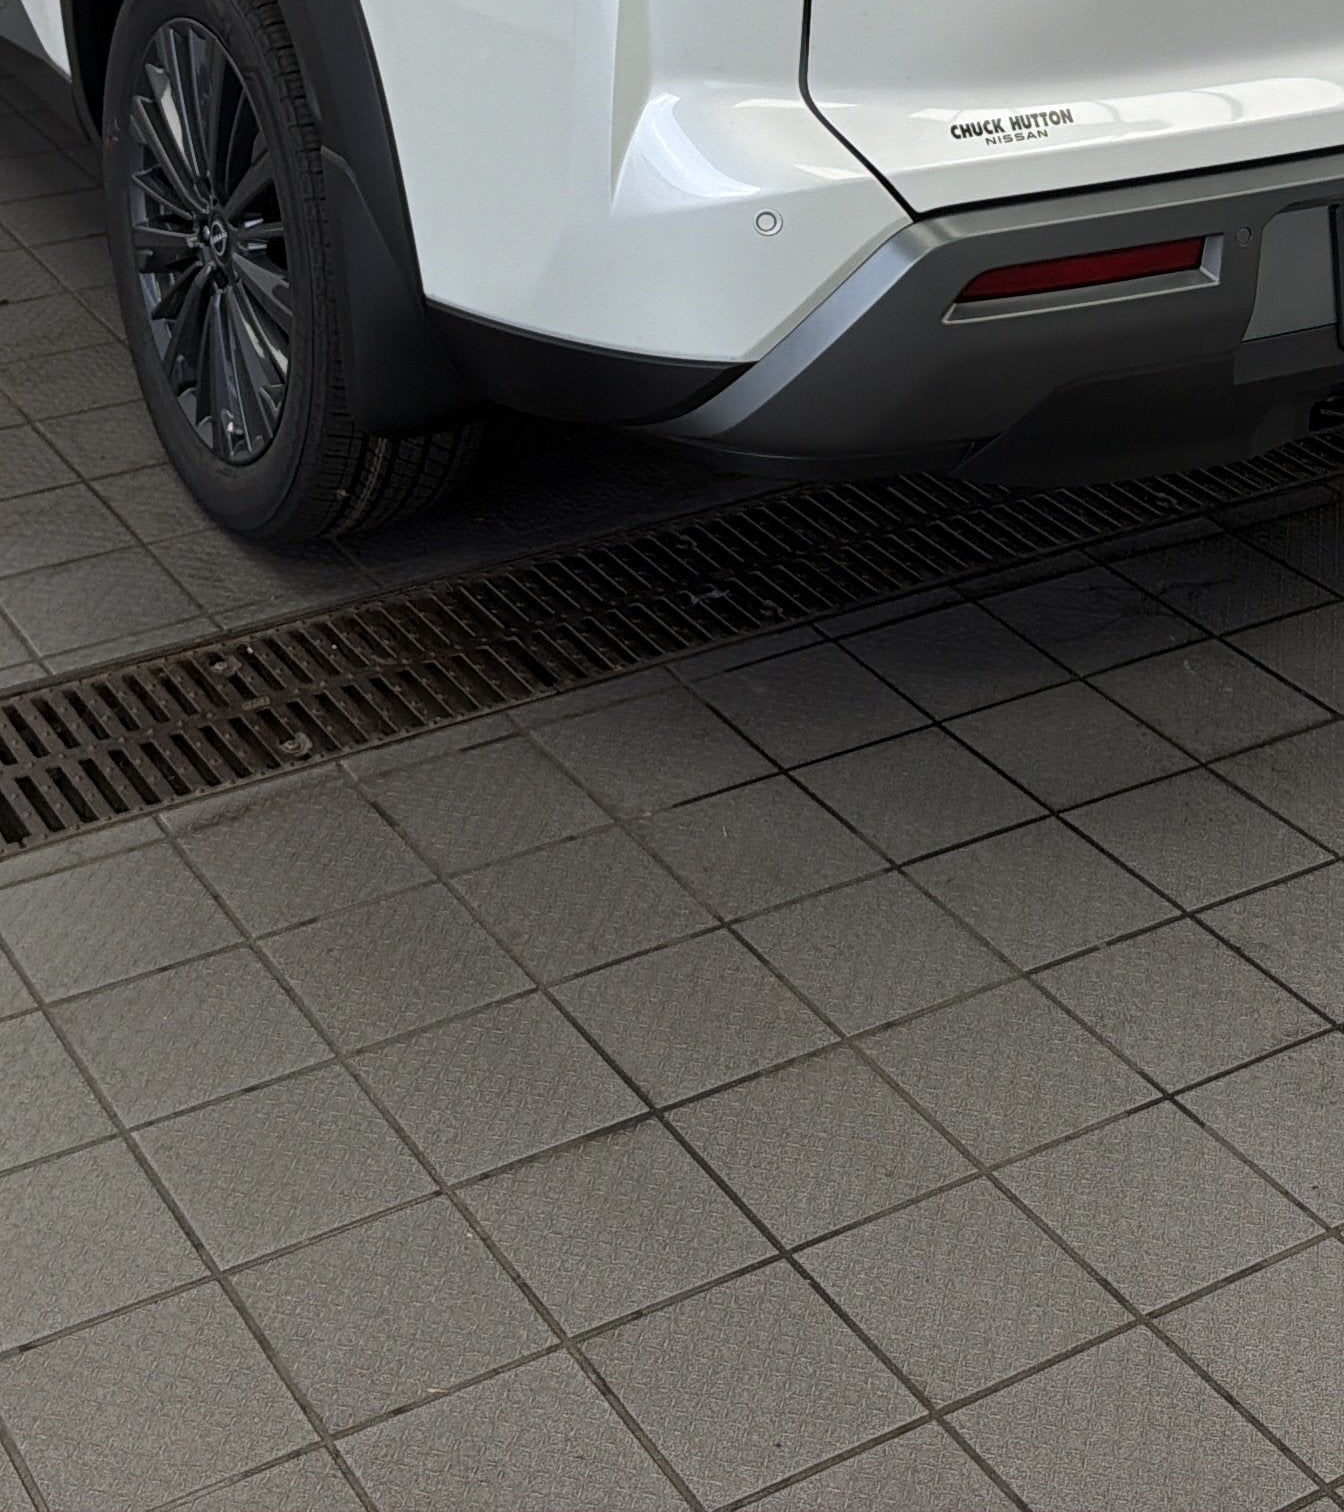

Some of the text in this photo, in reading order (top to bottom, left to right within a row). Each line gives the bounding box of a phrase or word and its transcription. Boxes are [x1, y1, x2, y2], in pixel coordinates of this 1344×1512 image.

[950, 108, 1074, 140] CHUCK HUTTON
[985, 129, 1049, 146] NISSAN
